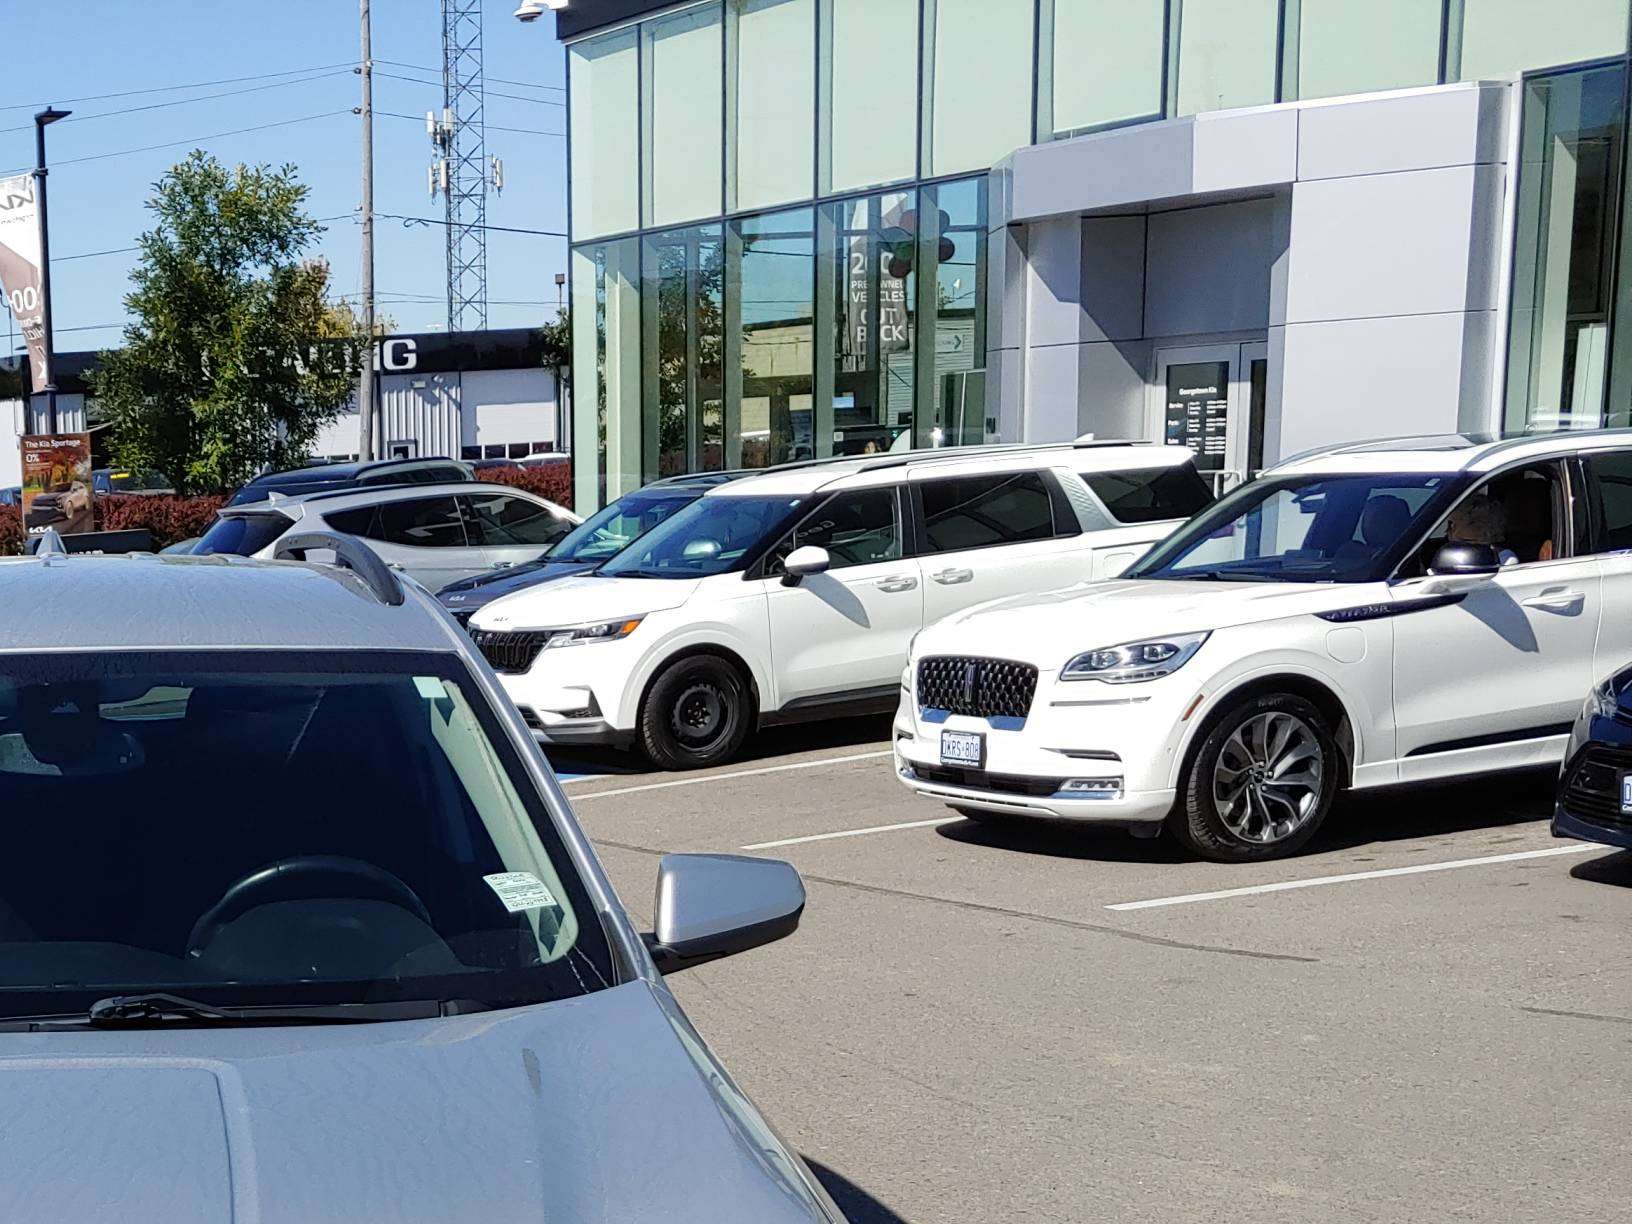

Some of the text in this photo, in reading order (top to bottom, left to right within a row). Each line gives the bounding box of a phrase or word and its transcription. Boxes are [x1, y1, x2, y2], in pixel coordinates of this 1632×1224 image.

[857, 325, 905, 343] BCK
[26, 439, 81, 449] The Kia Sportage
[26, 453, 40, 463] 0%
